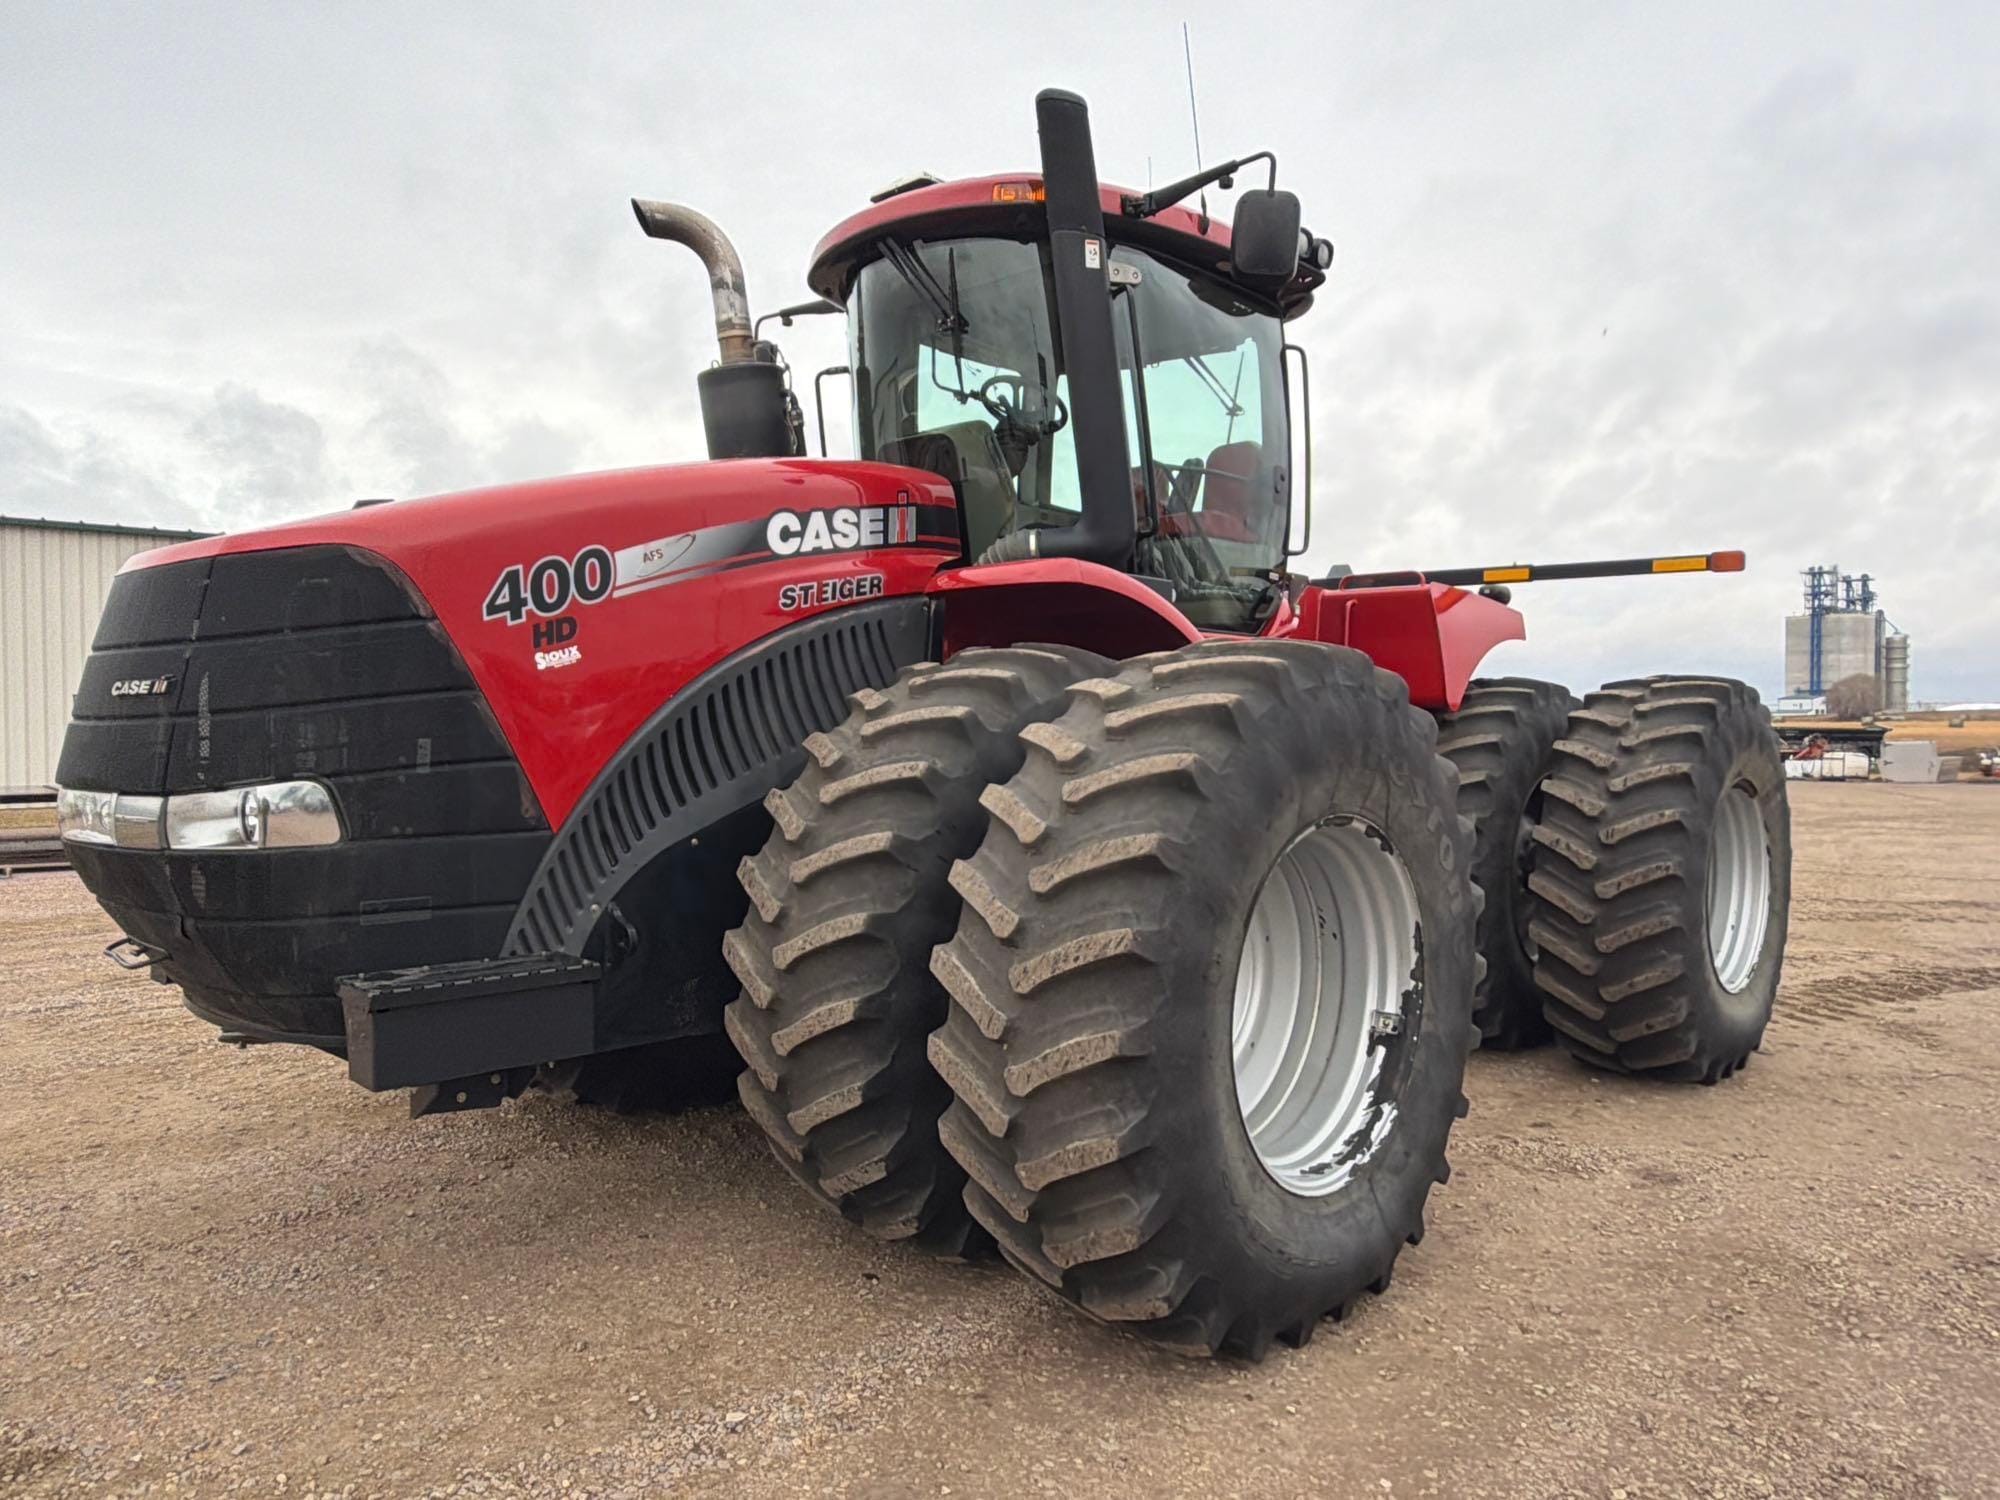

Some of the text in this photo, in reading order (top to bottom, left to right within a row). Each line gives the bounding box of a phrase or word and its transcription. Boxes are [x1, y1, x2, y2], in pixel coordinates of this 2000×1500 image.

[767, 508, 884, 556] CASE
[642, 548, 664, 564] AFS
[483, 544, 615, 626] 400
[779, 573, 884, 611] STEIGER
[532, 616, 578, 649] HD
[111, 680, 151, 696] CASE
